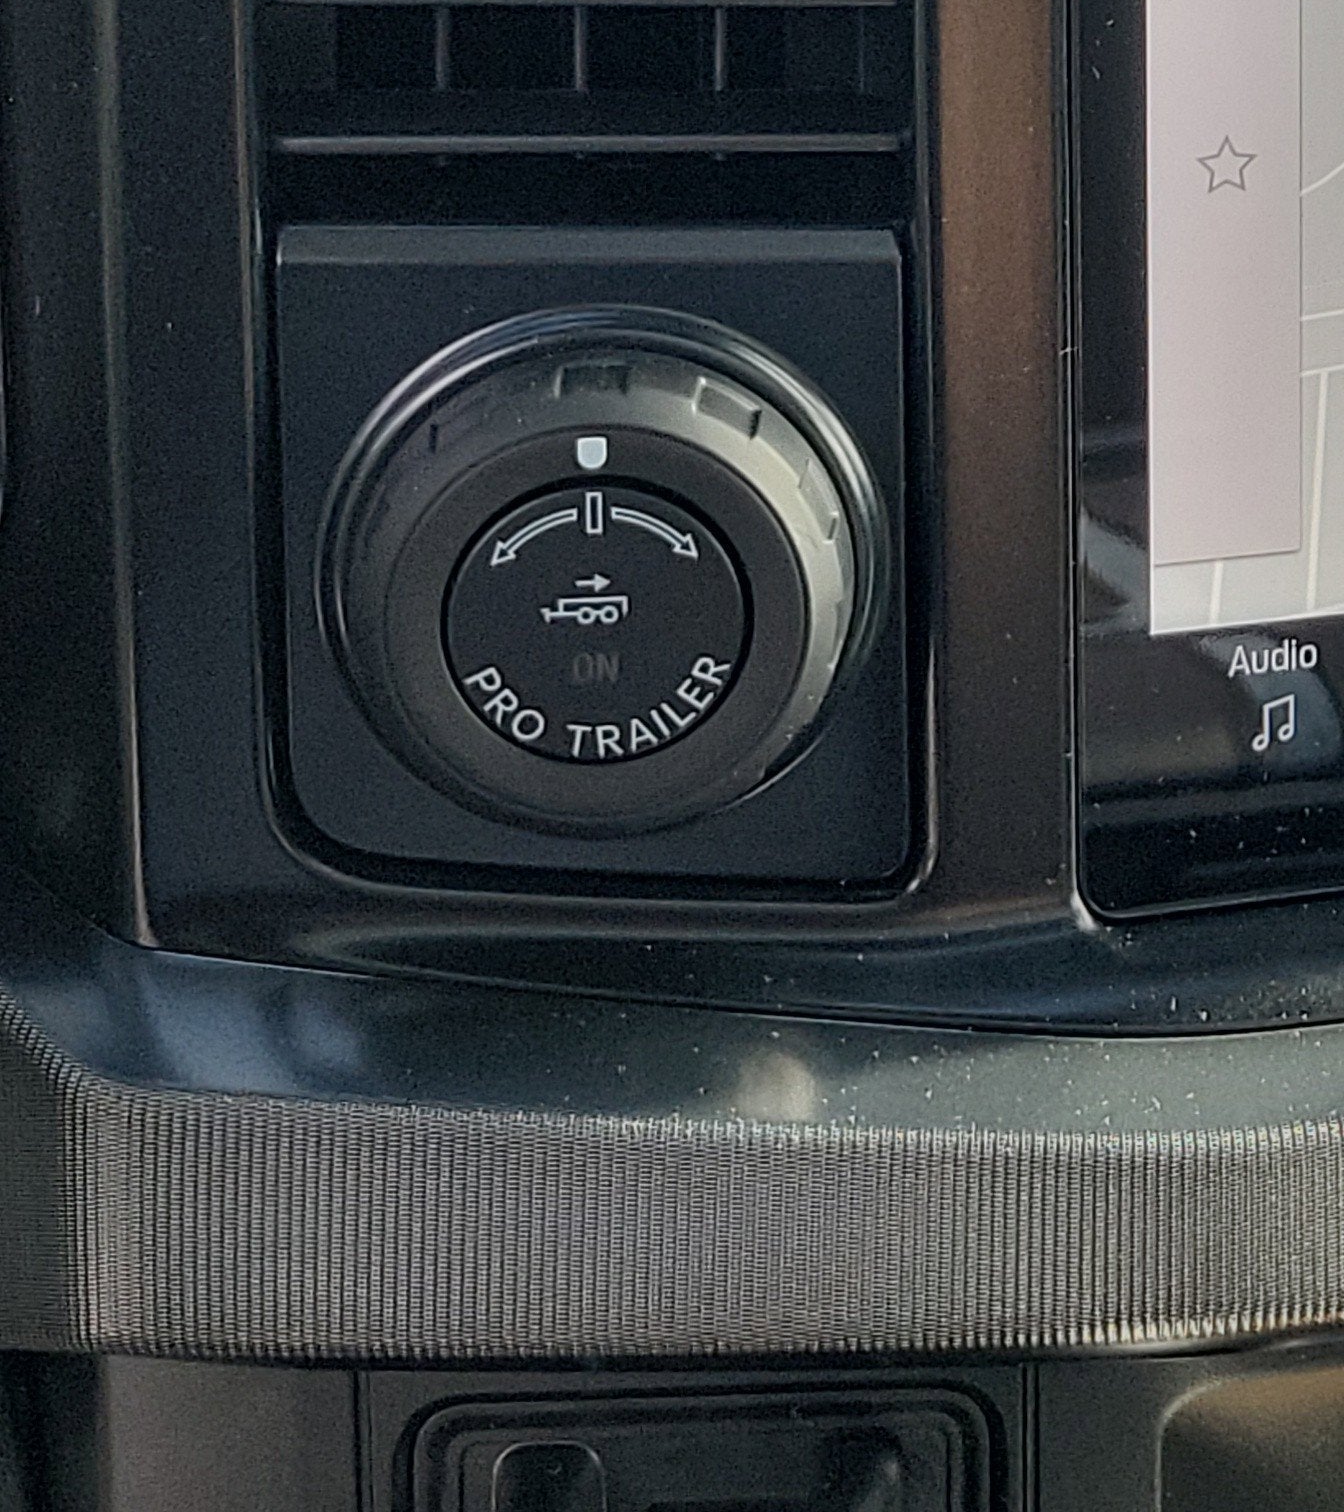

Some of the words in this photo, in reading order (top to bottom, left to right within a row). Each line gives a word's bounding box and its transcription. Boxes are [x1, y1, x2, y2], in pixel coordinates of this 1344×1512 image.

[572, 652, 622, 682] ON
[1227, 639, 1319, 679] Audio
[463, 664, 547, 744] PRO
[565, 653, 733, 759] TRAILER
